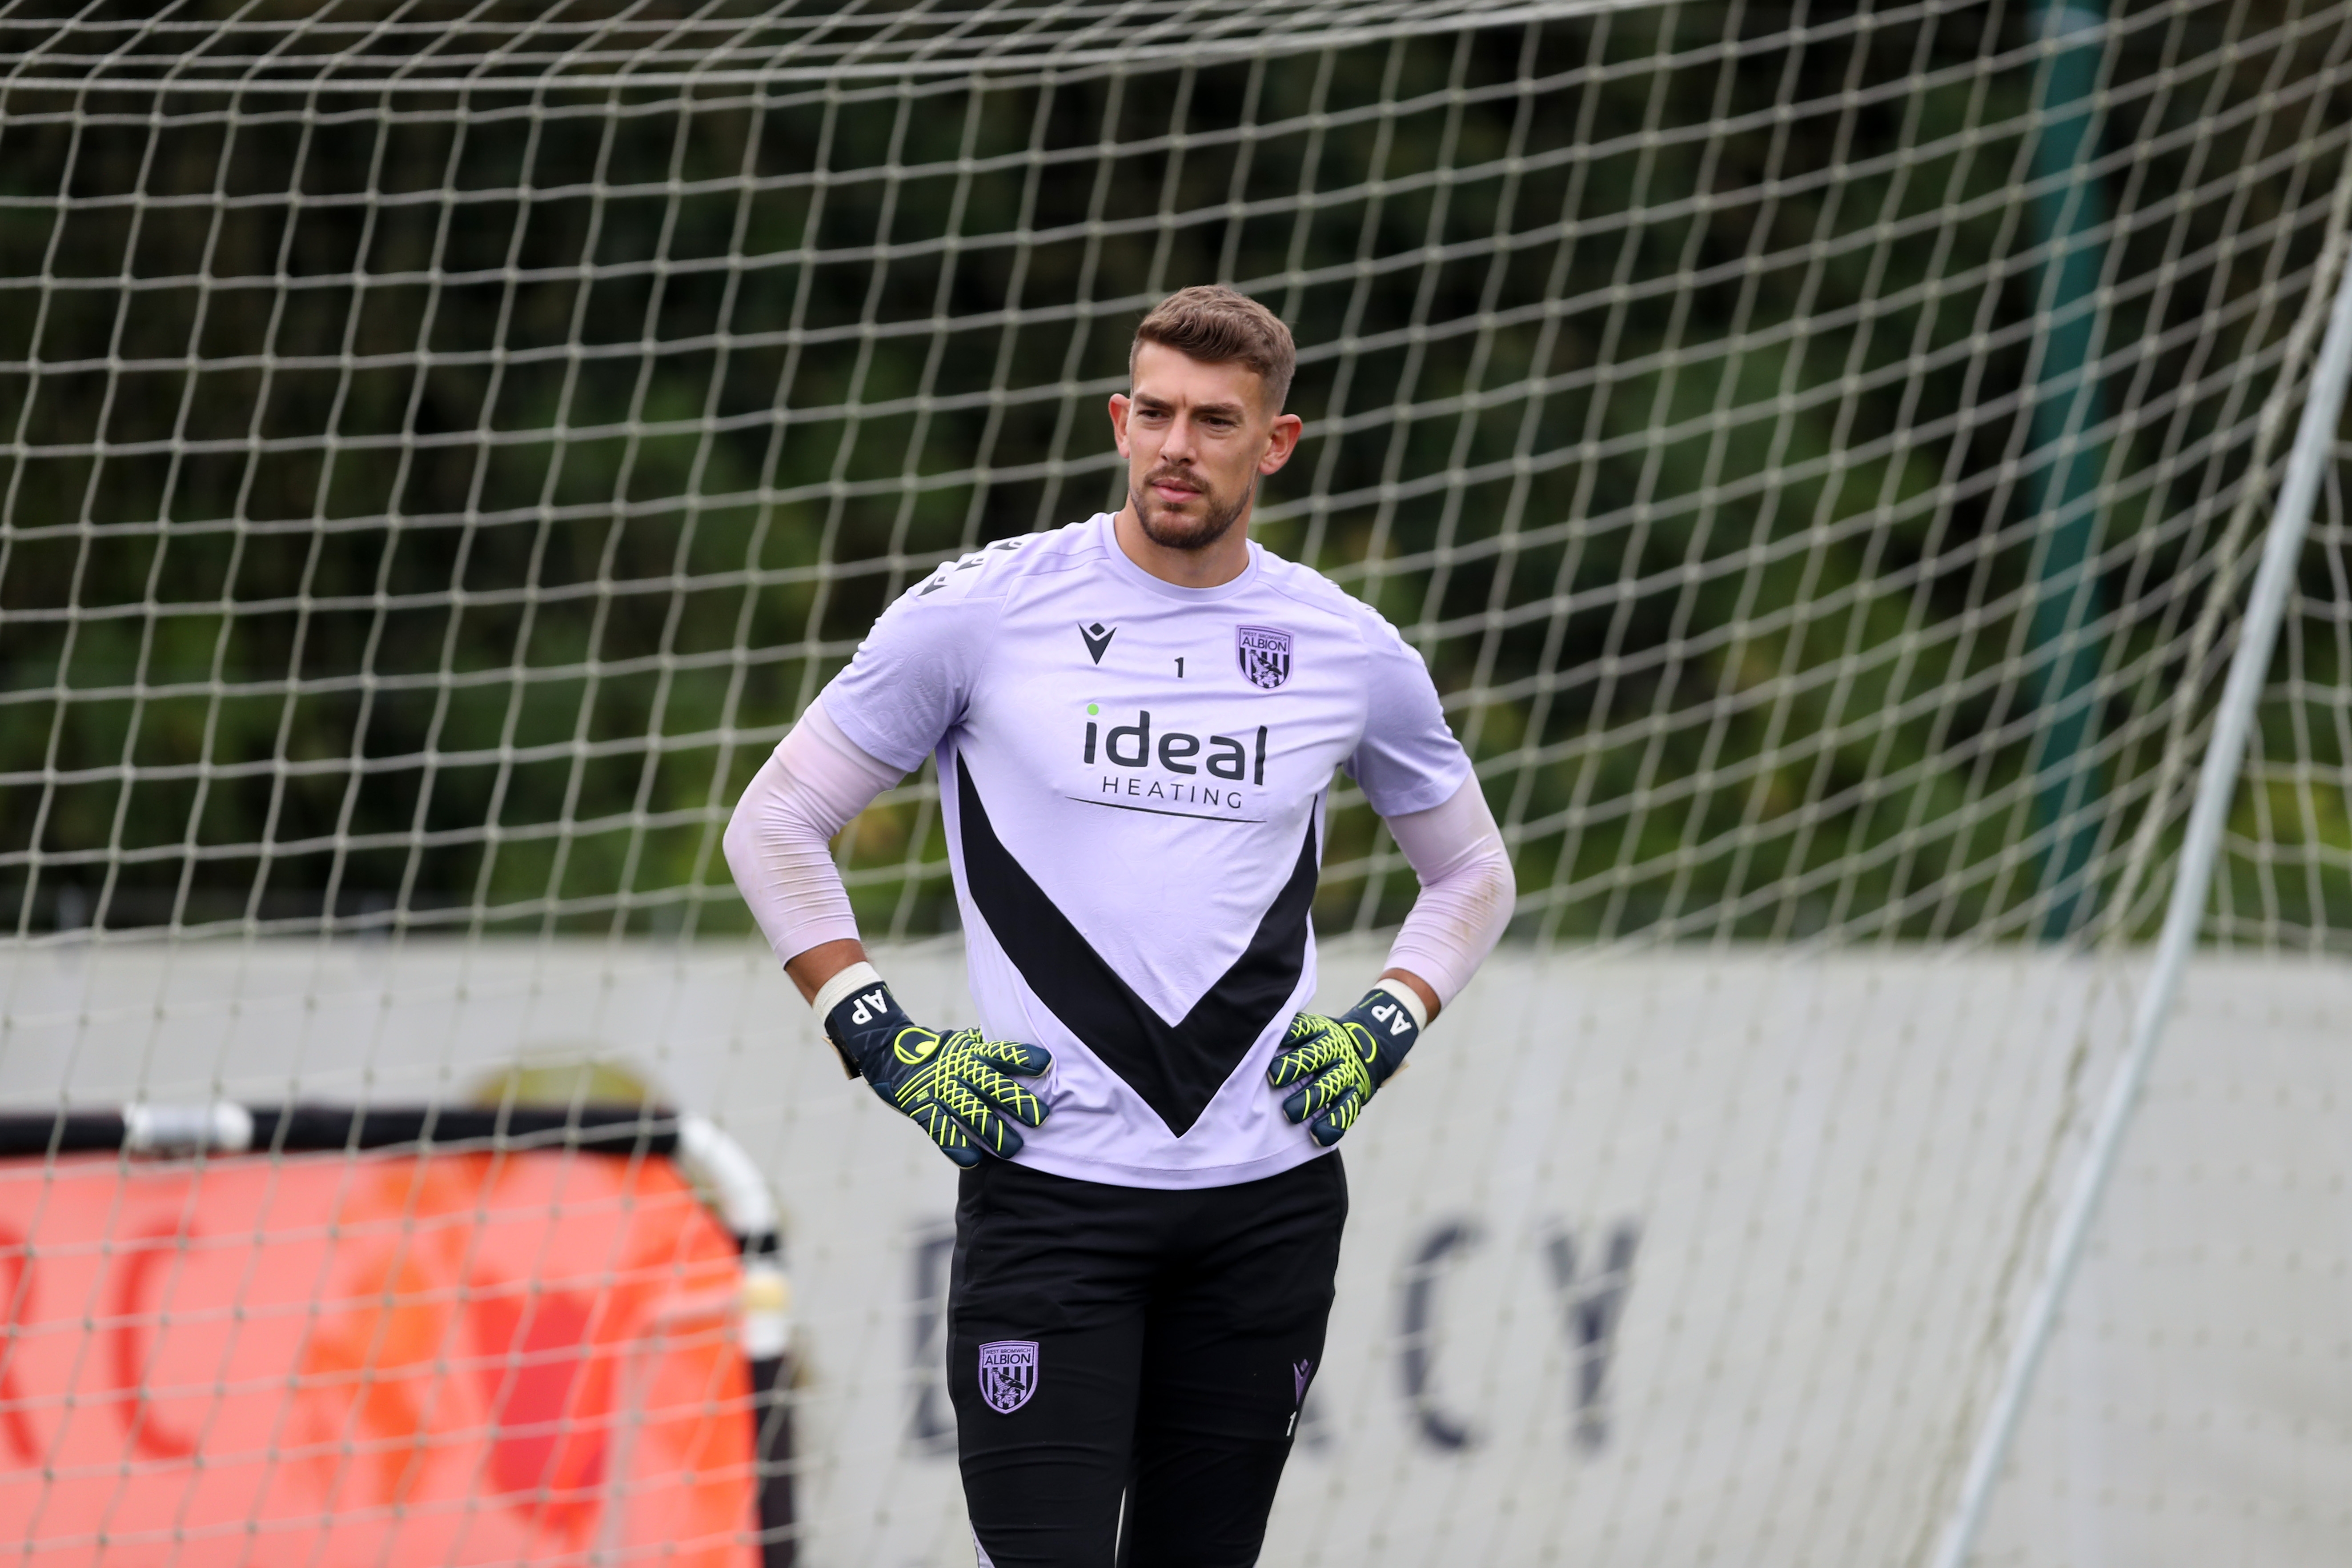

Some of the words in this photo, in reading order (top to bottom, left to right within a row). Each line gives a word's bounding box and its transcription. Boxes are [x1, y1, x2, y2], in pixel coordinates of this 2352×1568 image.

[1242, 637, 1286, 652] ALBION
[1174, 656, 1184, 679] 1
[1084, 704, 1267, 785] ideal
[1102, 776, 1242, 809] HEATING
[851, 988, 888, 1025] AP
[1371, 1003, 1412, 1036] AP
[985, 1354, 1030, 1365] ALBION
[1286, 1411, 1297, 1436] 1
